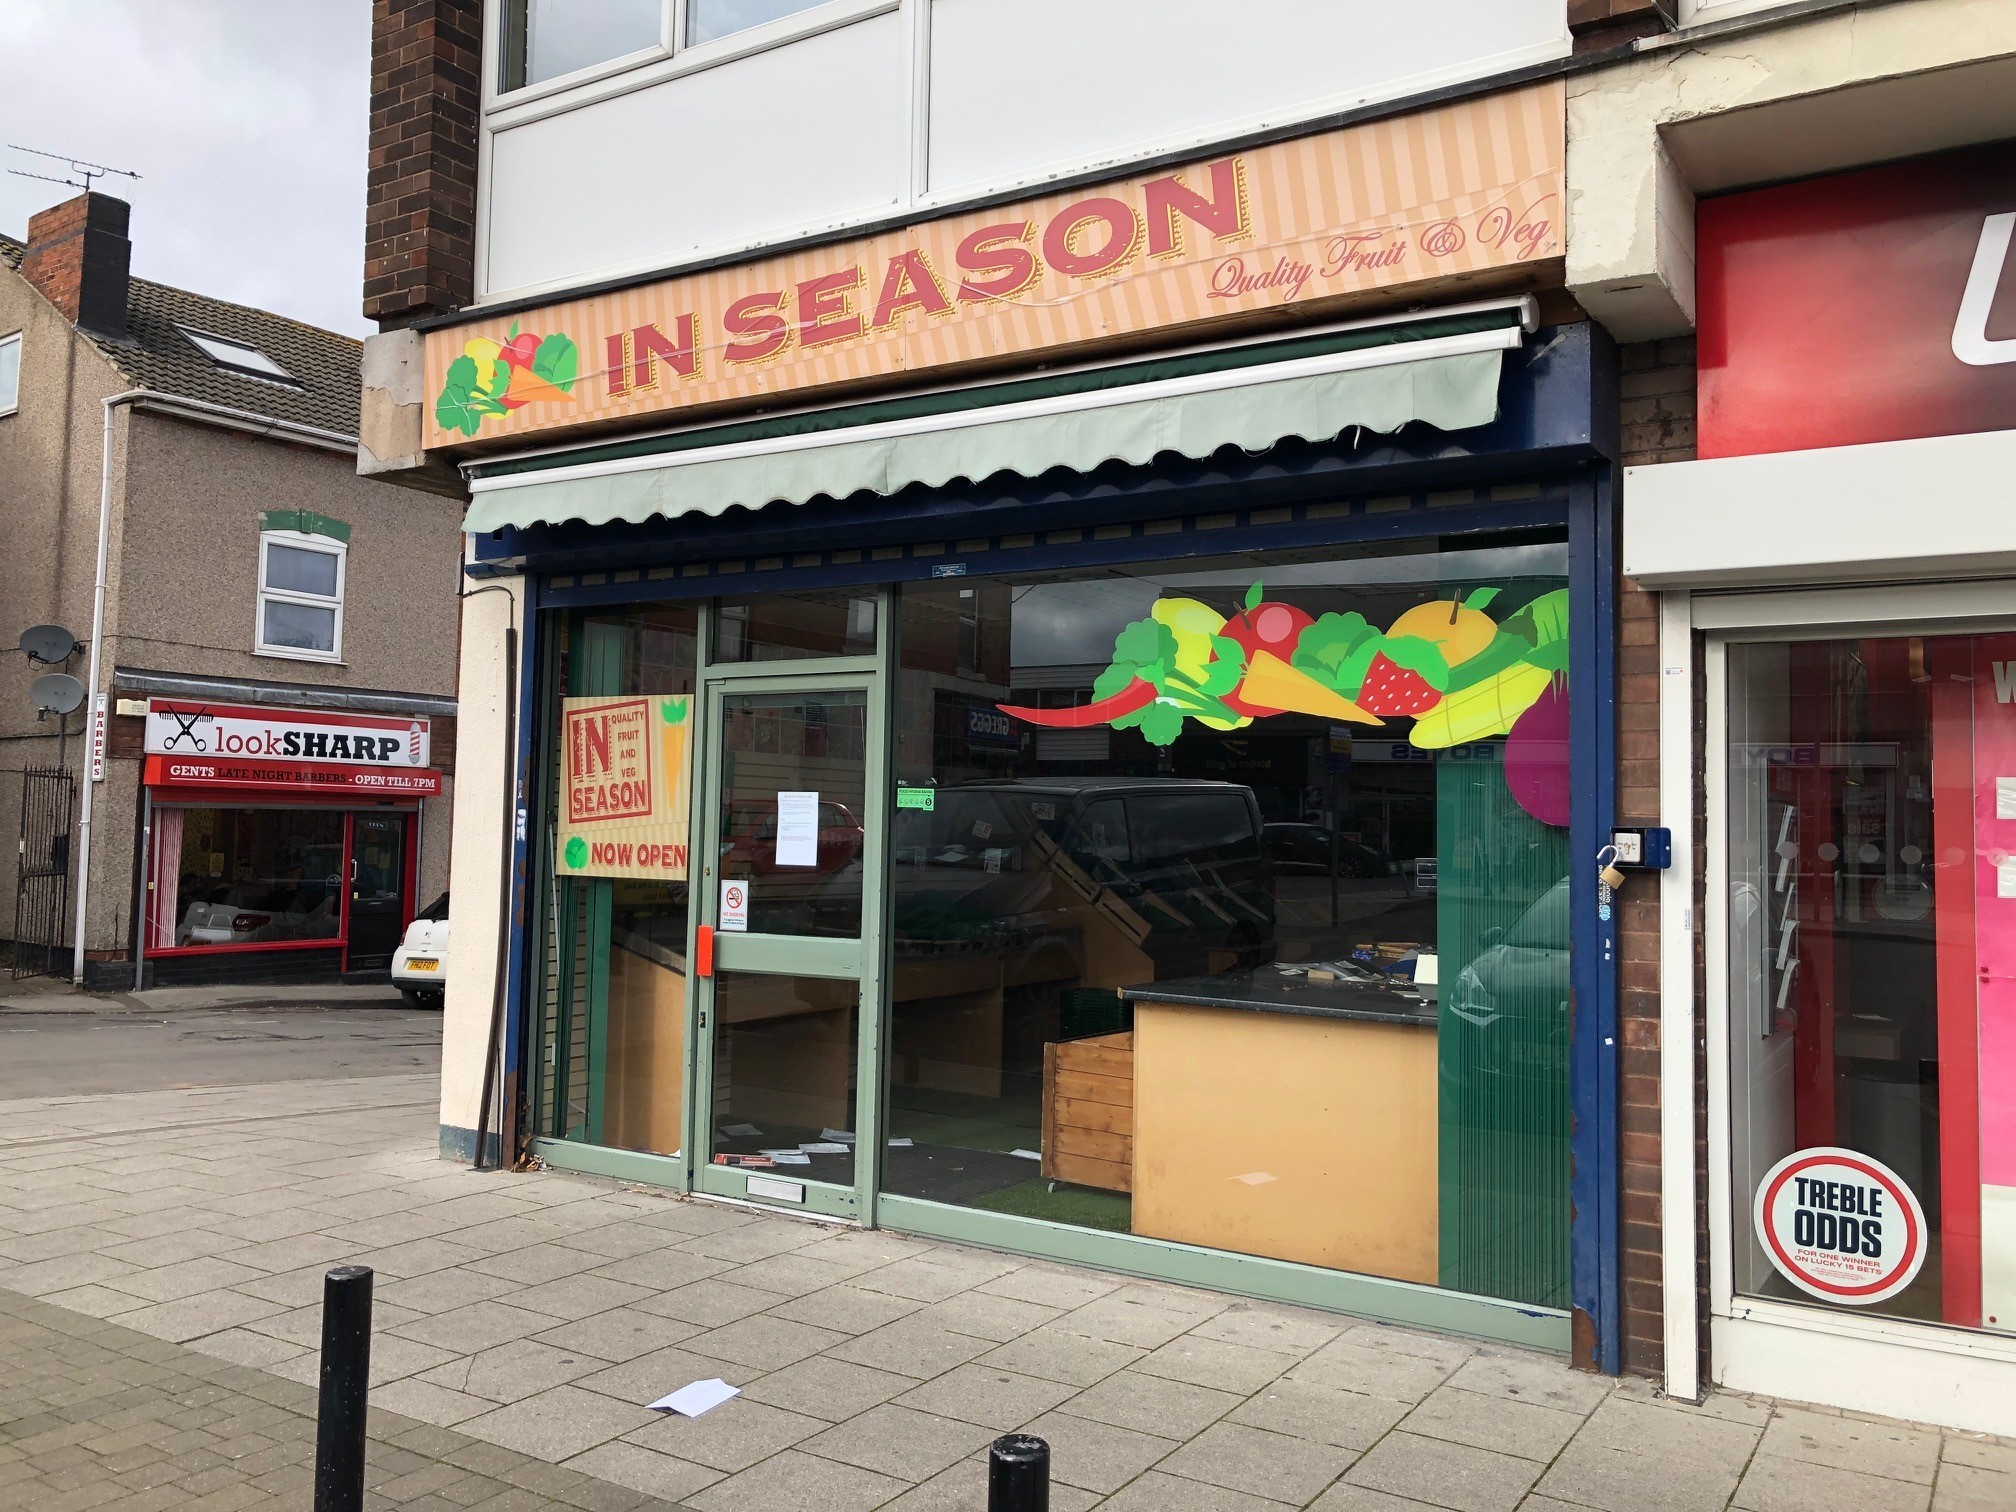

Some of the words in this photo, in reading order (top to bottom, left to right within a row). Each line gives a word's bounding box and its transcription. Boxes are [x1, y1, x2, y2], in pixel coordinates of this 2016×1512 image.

[1207, 256, 1313, 302] Quality
[1320, 231, 1407, 278] Fruit
[1420, 216, 1466, 258] &
[604, 312, 704, 398] IN
[723, 157, 1254, 366] SEASON
[611, 710, 644, 725] QUALITY
[94, 711, 104, 776] BARBERS
[572, 714, 613, 780] IN
[617, 729, 640, 742] FRUIT
[619, 748, 636, 760] AND
[170, 765, 215, 777] GENTS
[217, 767, 250, 779] LATE
[252, 769, 292, 781] NIGHT
[295, 771, 346, 783] BARBERS
[354, 775, 386, 786] OPEN
[388, 777, 411, 787] TILL
[413, 778, 436, 788] 7PM
[621, 767, 636, 778] VEG
[572, 779, 647, 816] SEASON
[591, 842, 633, 867] NOW
[637, 843, 686, 870] OPEN
[1795, 1177, 1882, 1218] TREBLE
[1794, 1208, 1882, 1258] ODDS
[1794, 1255, 1808, 1263] ON
[1811, 1257, 1843, 1268] LUCKY
[1797, 1248, 1817, 1257] FOR
[1819, 1252, 1839, 1260] ONE
[1841, 1256, 1880, 1268] WINNER
